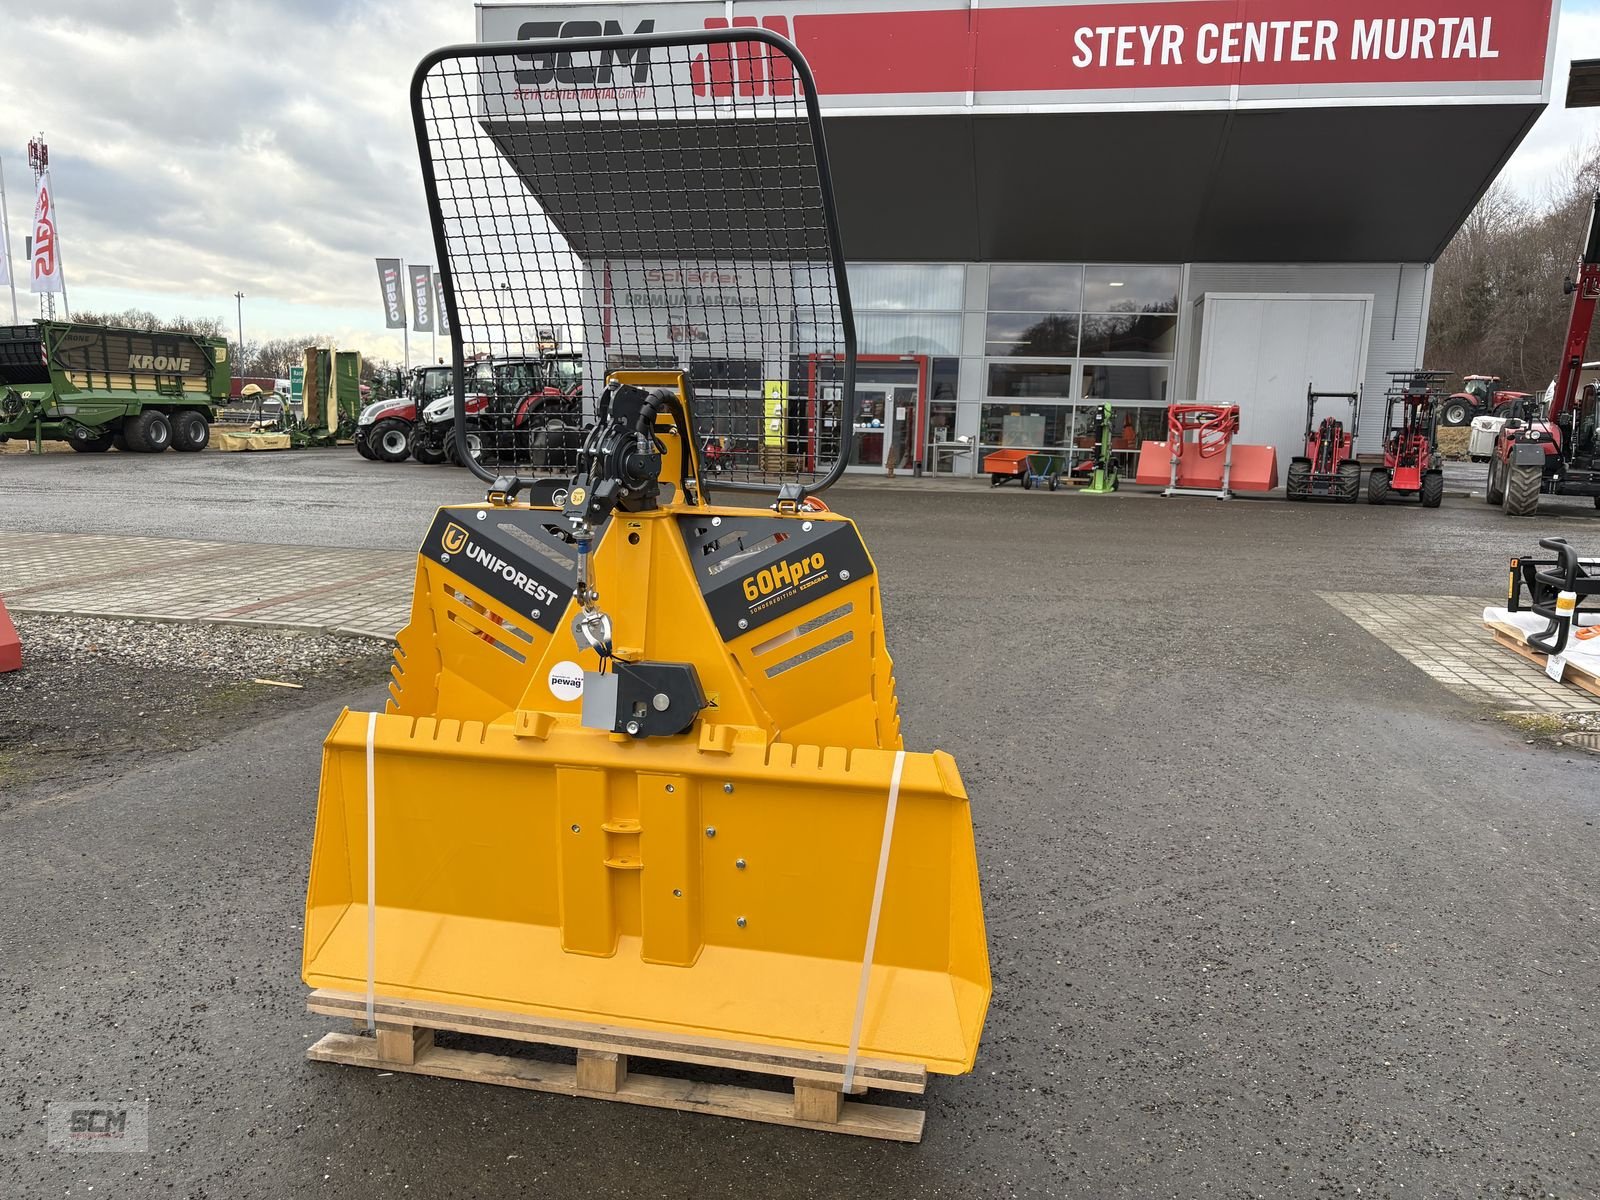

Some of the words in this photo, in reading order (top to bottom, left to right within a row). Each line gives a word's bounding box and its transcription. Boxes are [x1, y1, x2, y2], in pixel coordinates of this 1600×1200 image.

[513, 19, 655, 84] SCM
[1072, 25, 1185, 68] STEYR
[1196, 20, 1339, 64] CENTER
[1351, 16, 1499, 60] MURTAL
[543, 87, 578, 100] CENTER
[580, 87, 615, 100] MURTAL
[618, 86, 646, 99] GmbH
[128, 354, 191, 372] KRONE
[465, 541, 558, 606] UNIFOREST
[742, 552, 826, 602] 60Hpro
[750, 589, 797, 616] SONDEREDITION
[551, 677, 581, 689] pewag
